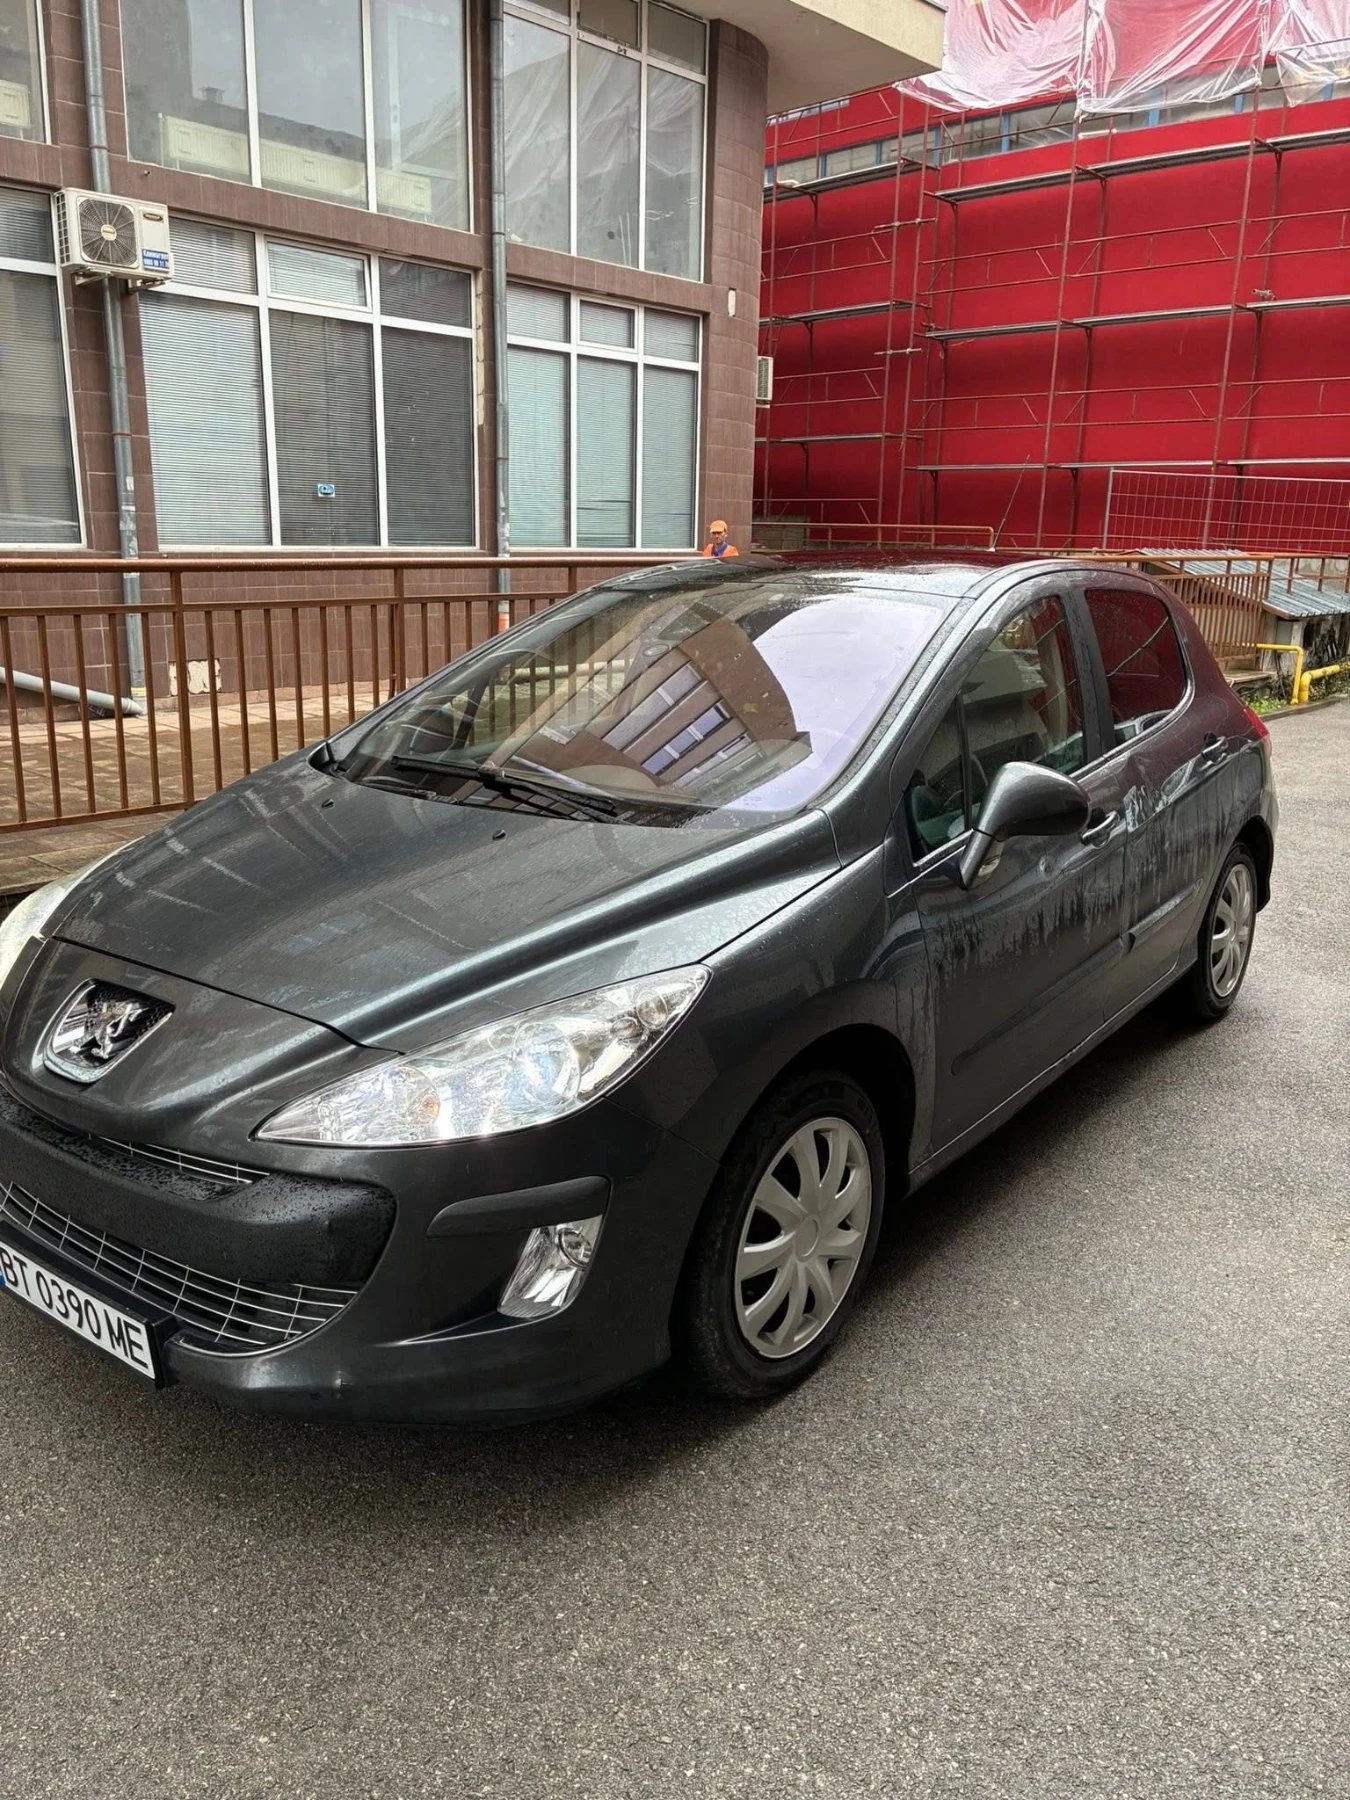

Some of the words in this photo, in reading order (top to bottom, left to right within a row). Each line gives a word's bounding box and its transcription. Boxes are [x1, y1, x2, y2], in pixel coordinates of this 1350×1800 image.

[0, 1250, 30, 1297] BT
[36, 1270, 101, 1339] 0390
[103, 1308, 149, 1369] ME
